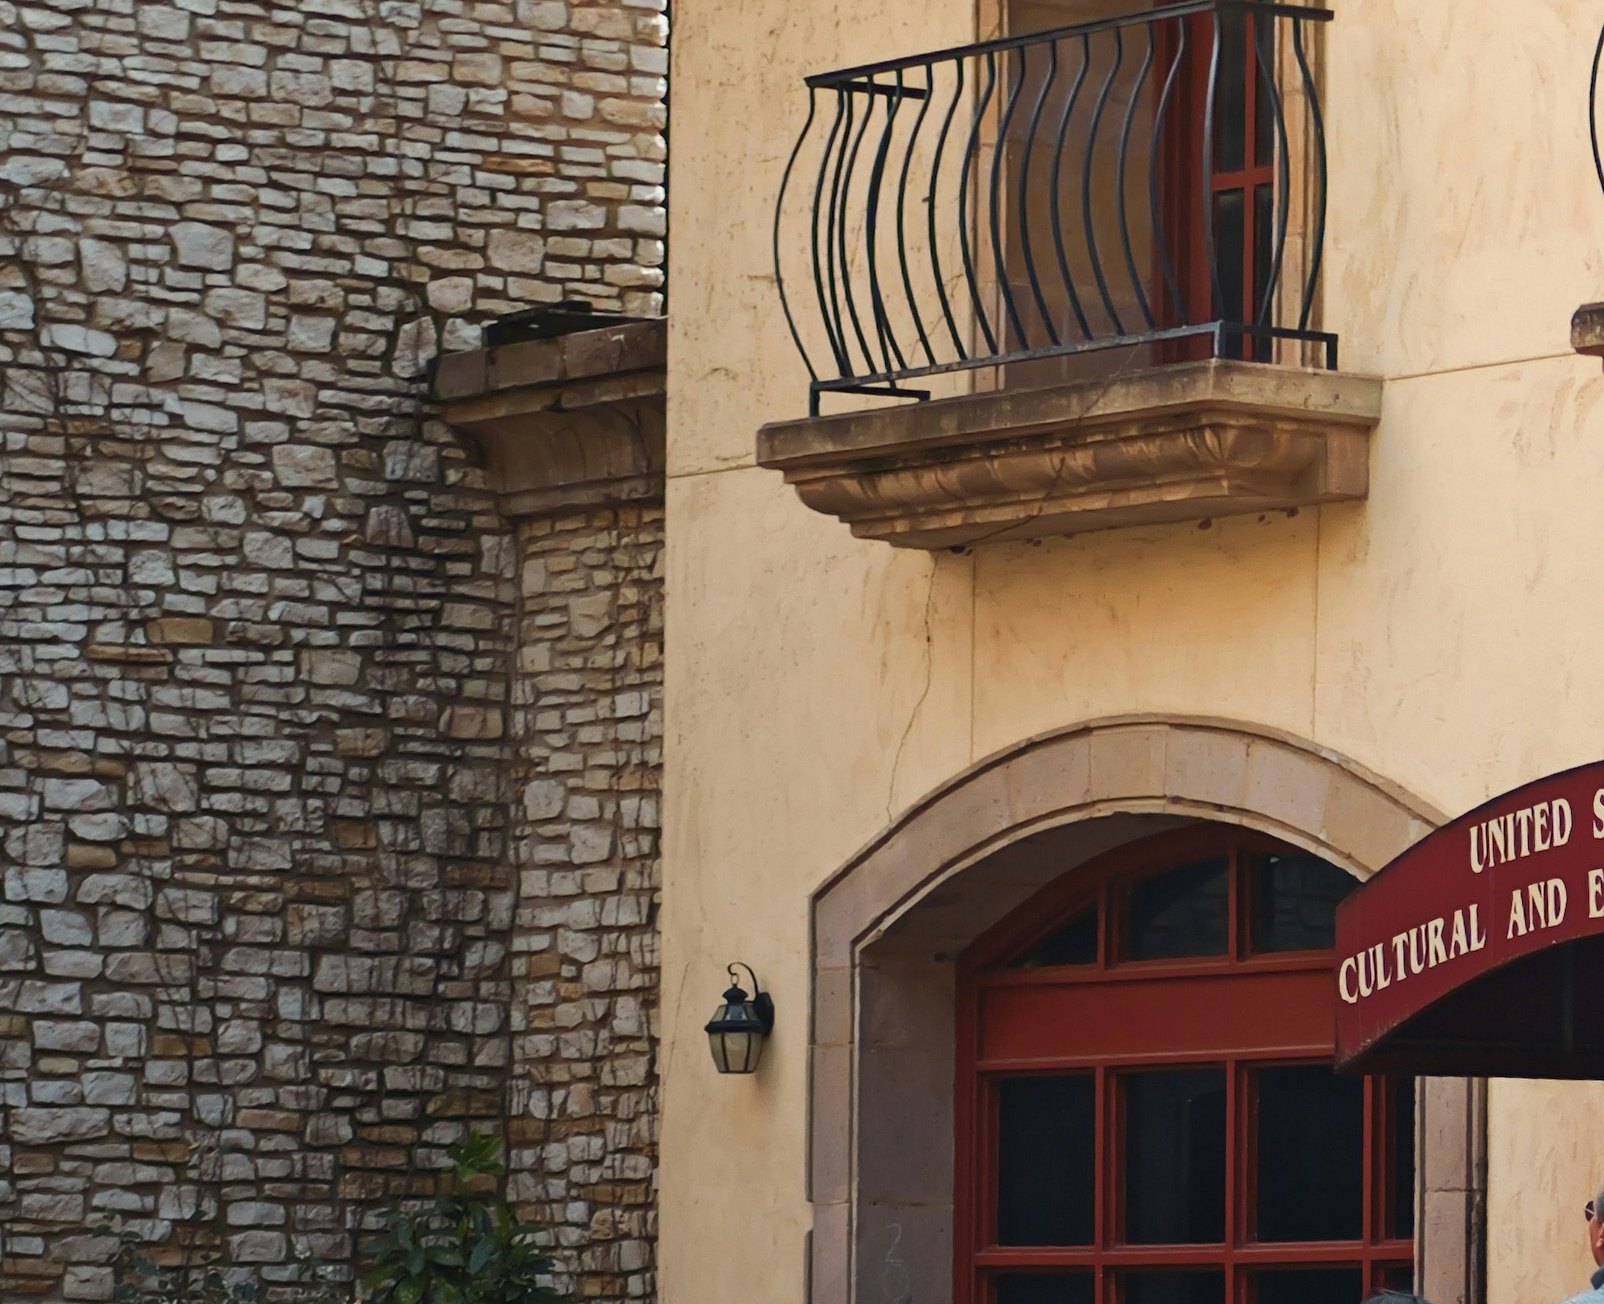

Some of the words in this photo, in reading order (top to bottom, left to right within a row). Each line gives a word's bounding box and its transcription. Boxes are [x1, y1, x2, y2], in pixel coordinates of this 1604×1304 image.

[1469, 798, 1572, 874] UNITED
[1338, 903, 1486, 1004] CULTURAL
[1506, 878, 1567, 939] AND
